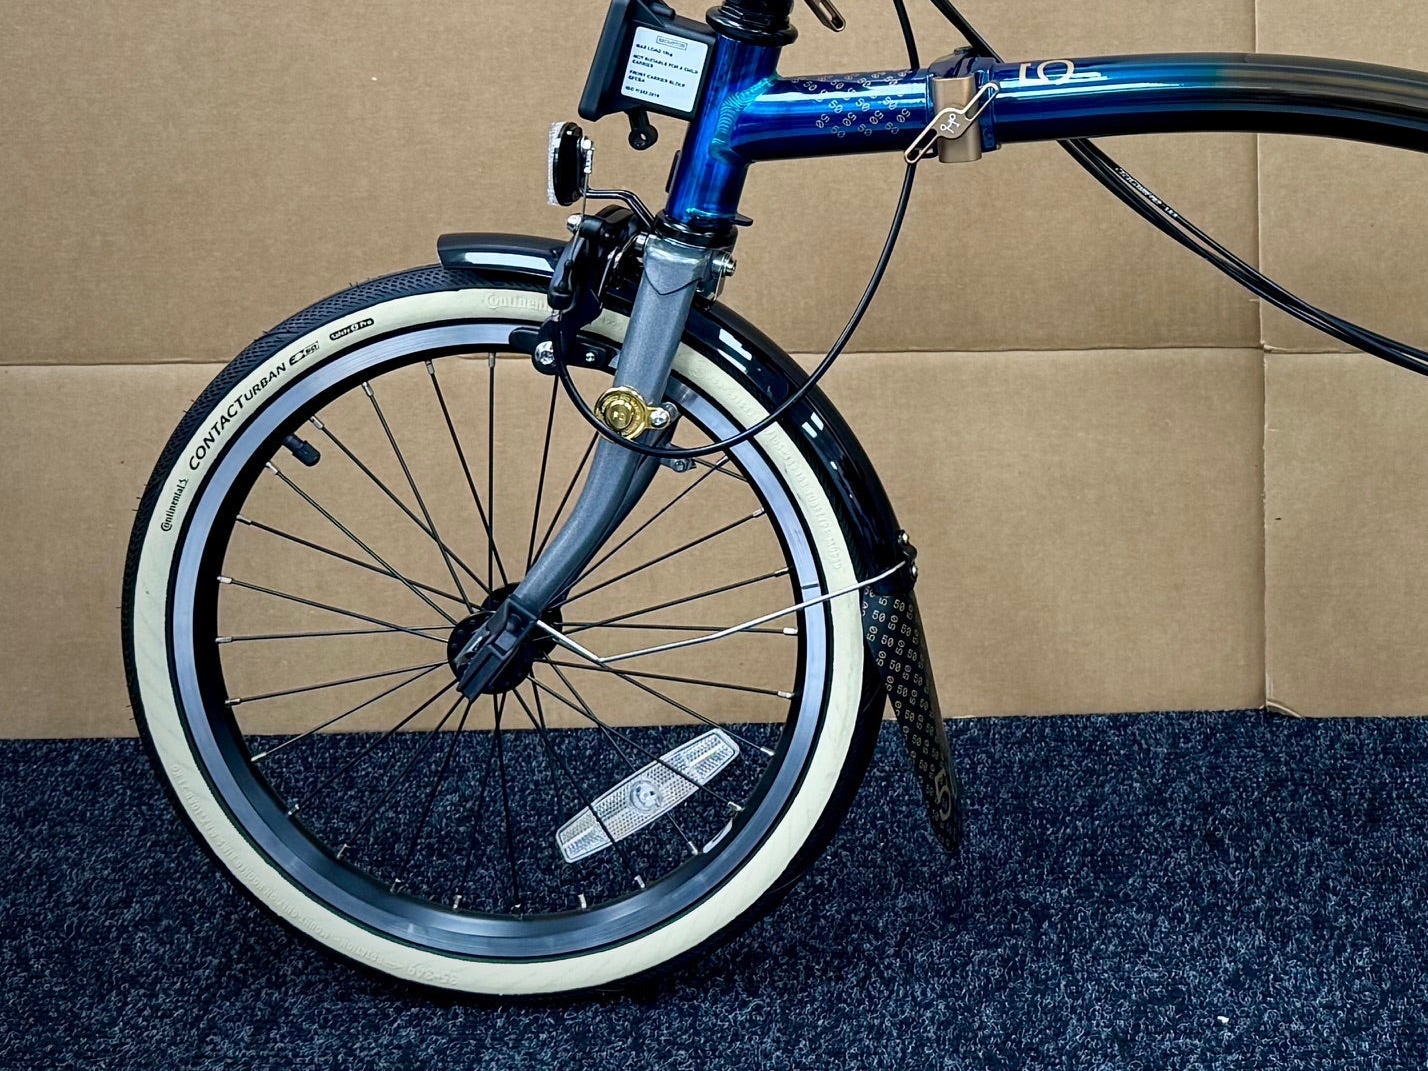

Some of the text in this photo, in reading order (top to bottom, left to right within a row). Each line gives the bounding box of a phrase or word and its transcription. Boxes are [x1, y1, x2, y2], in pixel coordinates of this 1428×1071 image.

[803, 81, 817, 91] 50
[831, 80, 844, 89] 50
[829, 100, 843, 113] 50
[856, 98, 870, 112] 50
[883, 97, 897, 110] 50
[816, 114, 830, 128] 50
[842, 112, 856, 126] 50
[870, 110, 884, 124] 50
[896, 108, 910, 123] 50
[831, 125, 845, 138] 50
[858, 124, 872, 136] 50
[885, 122, 899, 135] 50
